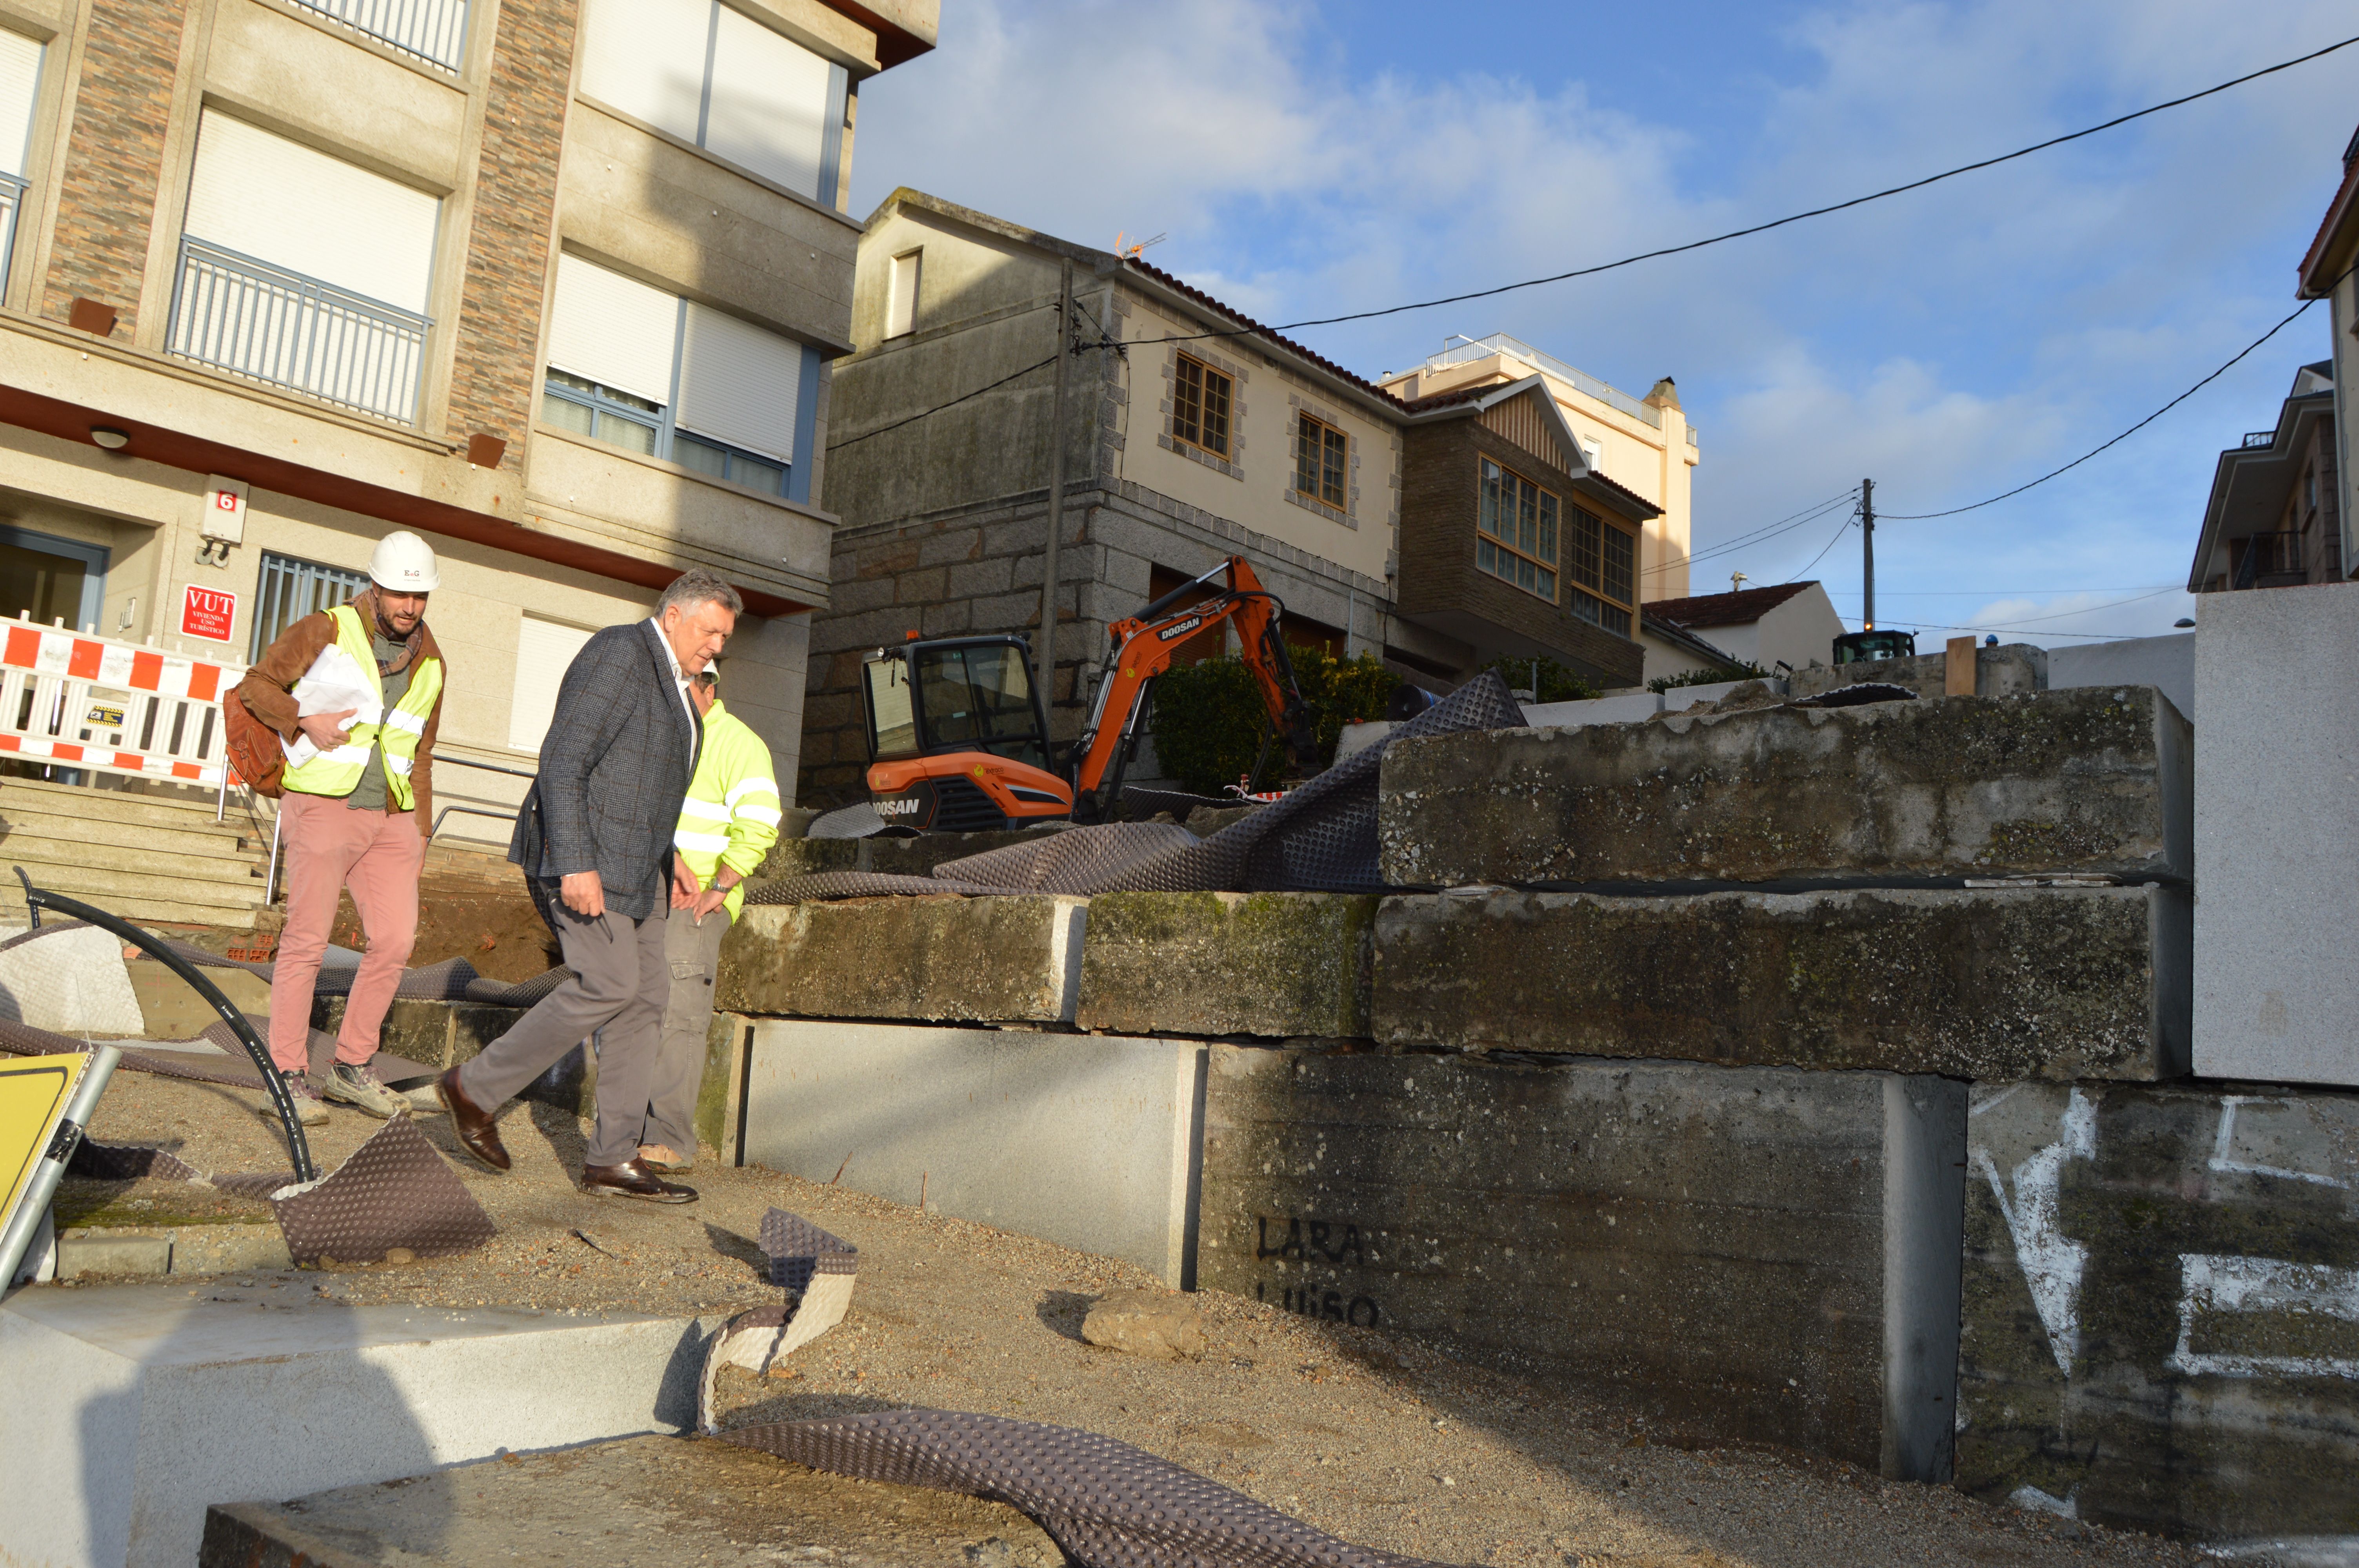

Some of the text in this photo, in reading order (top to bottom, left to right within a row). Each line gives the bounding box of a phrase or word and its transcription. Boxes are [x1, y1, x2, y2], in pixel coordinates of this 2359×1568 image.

[220, 494, 233, 509] 6
[188, 589, 234, 615] VUT
[193, 610, 224, 622] VIVIENDA
[201, 618, 215, 626] USO
[189, 622, 225, 635] TURÍSTICO
[1161, 617, 1199, 640] DOOSAN
[1256, 1216, 1364, 1265] LARA
